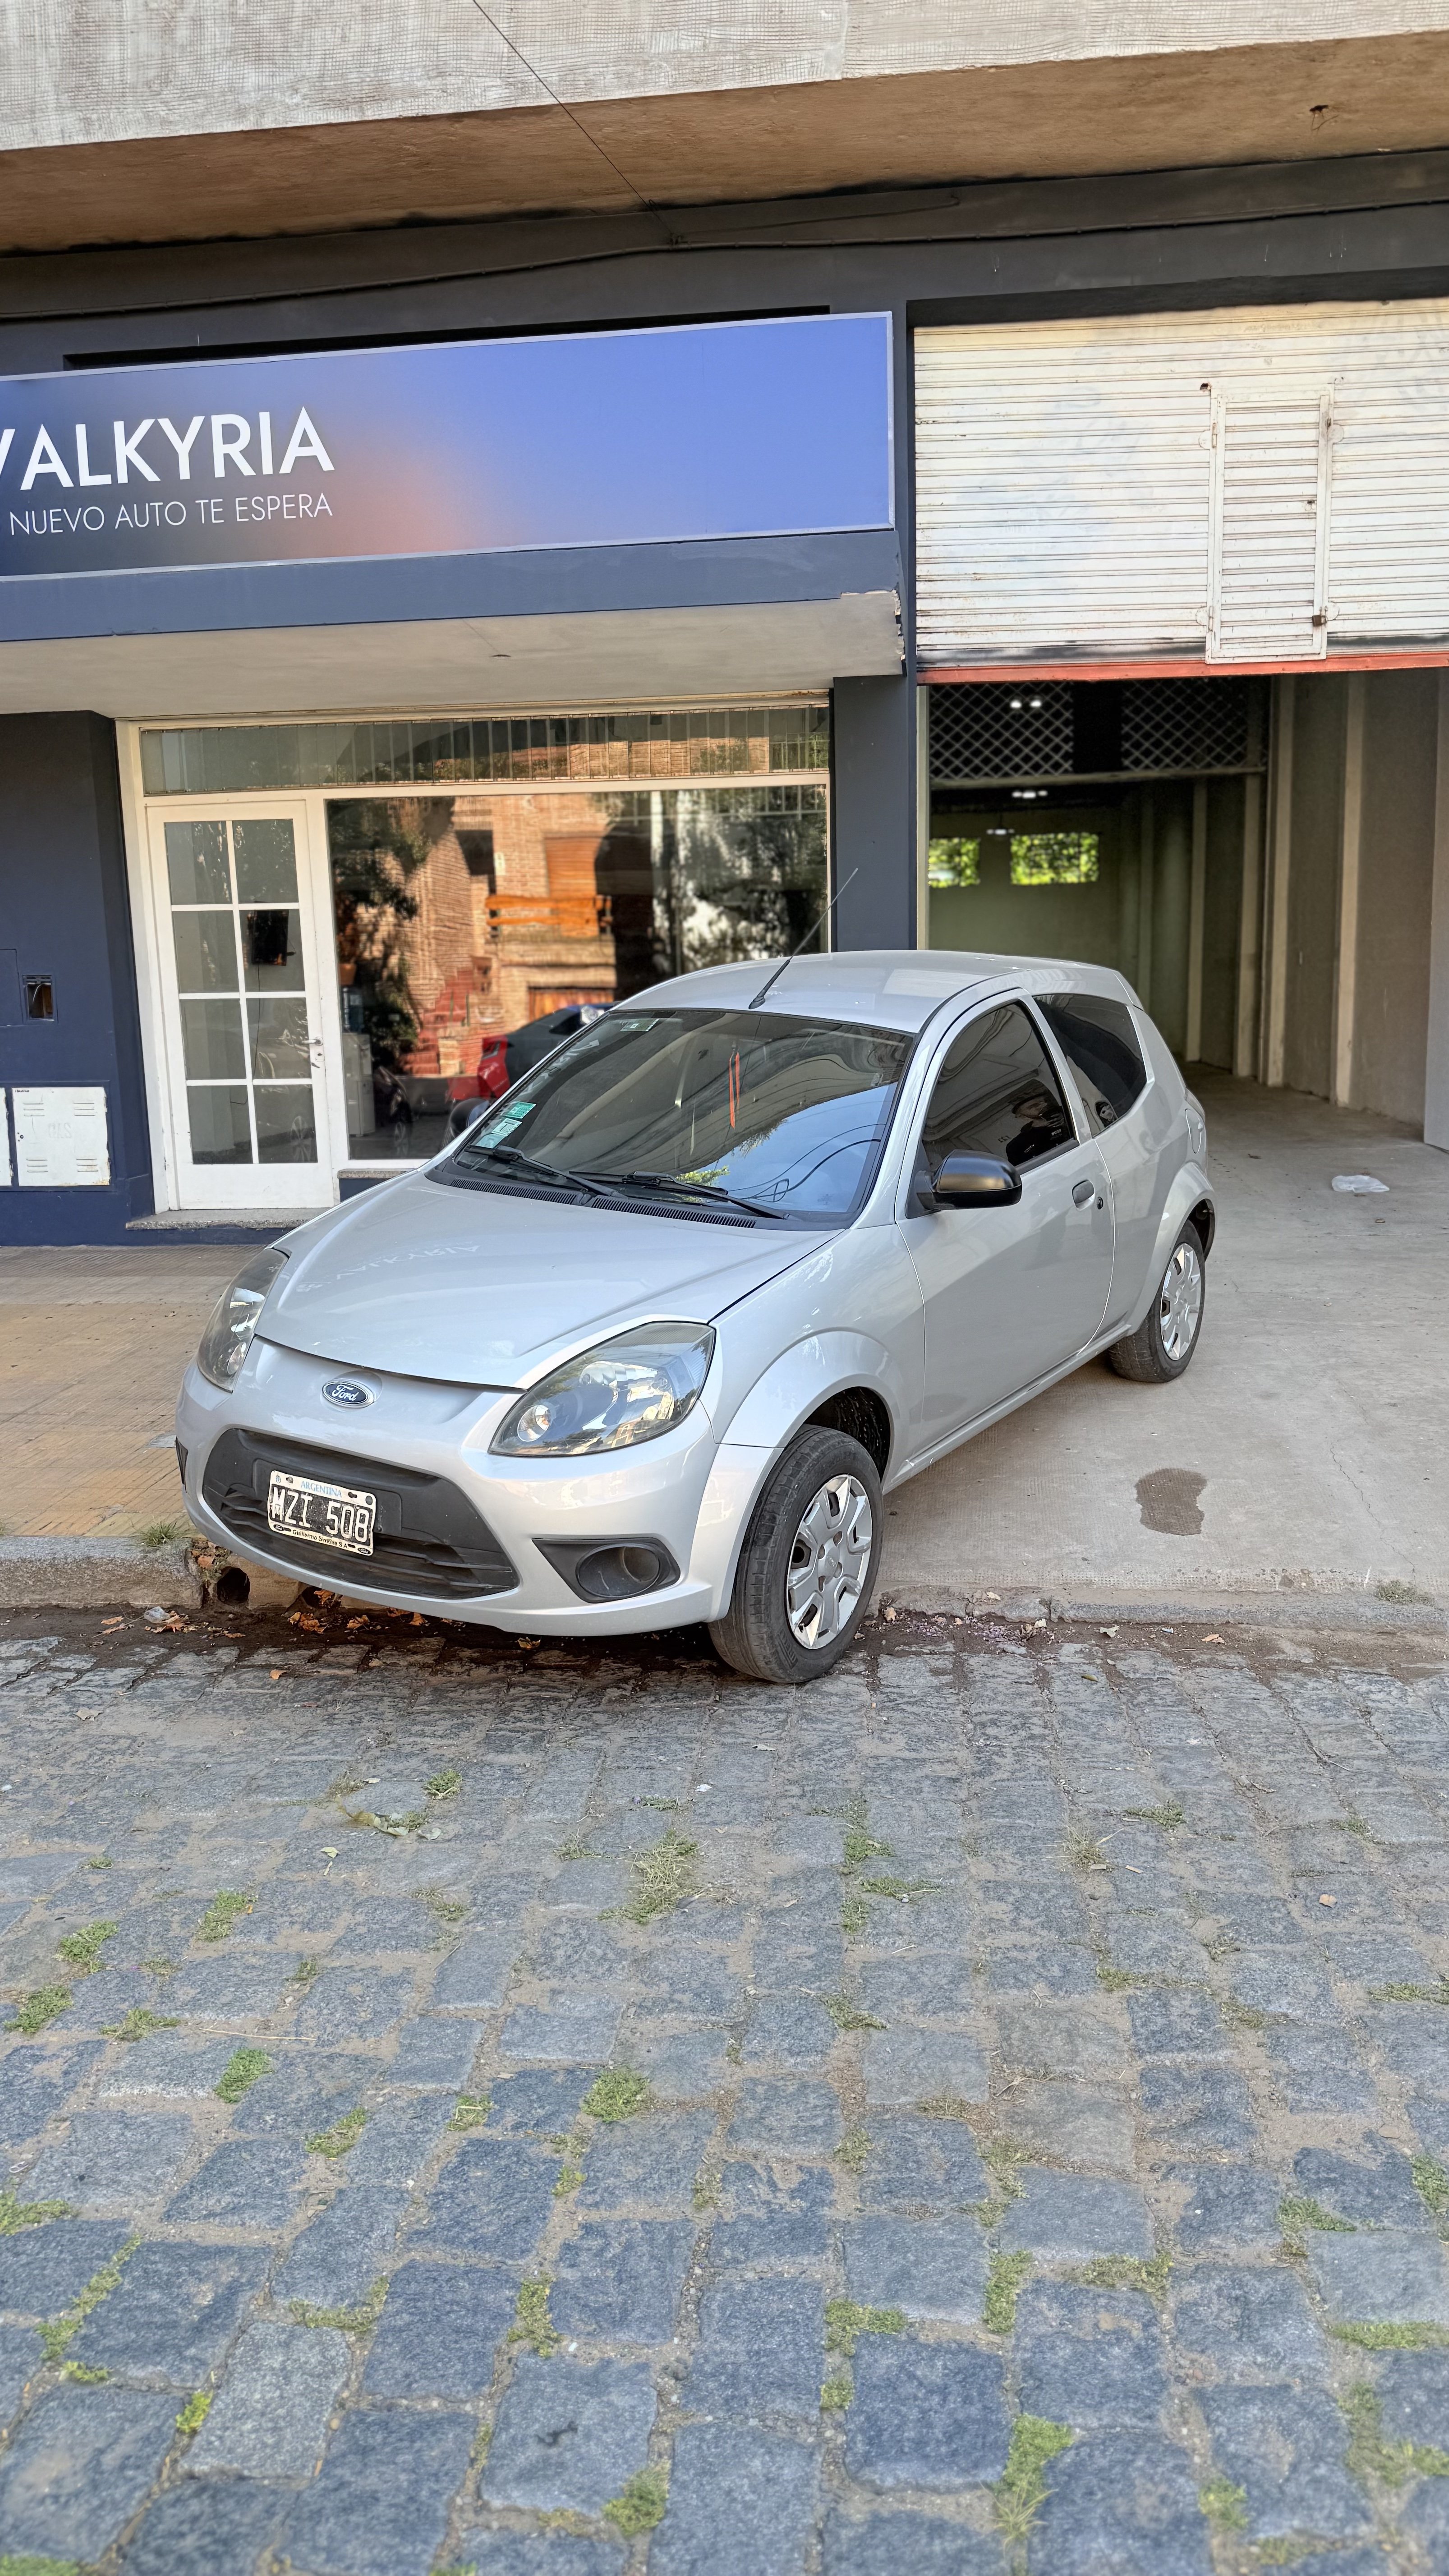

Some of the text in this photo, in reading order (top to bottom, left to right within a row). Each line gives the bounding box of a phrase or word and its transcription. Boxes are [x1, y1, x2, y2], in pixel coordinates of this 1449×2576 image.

[10, 492, 333, 536] NUEVO AUTO TE ESPERA
[331, 1384, 359, 1401] Ford
[301, 1481, 342, 1498] ARGENTINA
[271, 1487, 369, 1543] MZI 508
